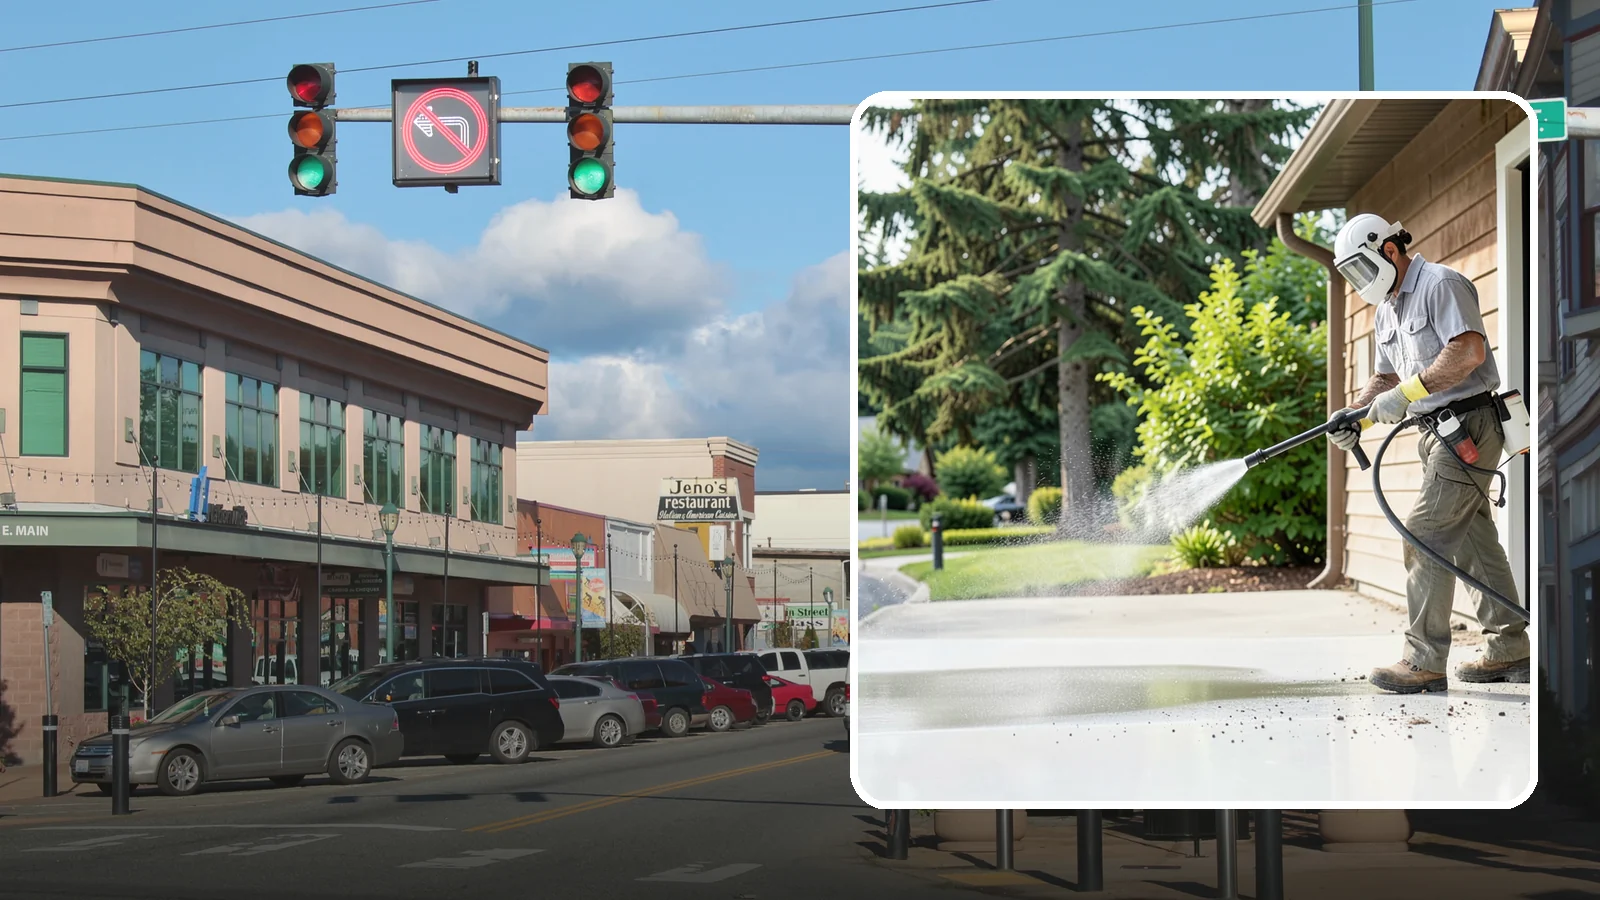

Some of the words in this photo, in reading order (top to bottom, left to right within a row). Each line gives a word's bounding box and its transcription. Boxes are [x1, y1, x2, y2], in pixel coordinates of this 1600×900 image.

[669, 480, 728, 495] Jeno's
[665, 496, 731, 509] restaurant
[658, 509, 682, 520] Italian
[685, 509, 715, 520] American
[715, 509, 738, 520] Cuisine
[2, 525, 13, 536] E.
[15, 525, 49, 537] MAIN
[797, 607, 829, 617] Street
[791, 619, 824, 627] lass
